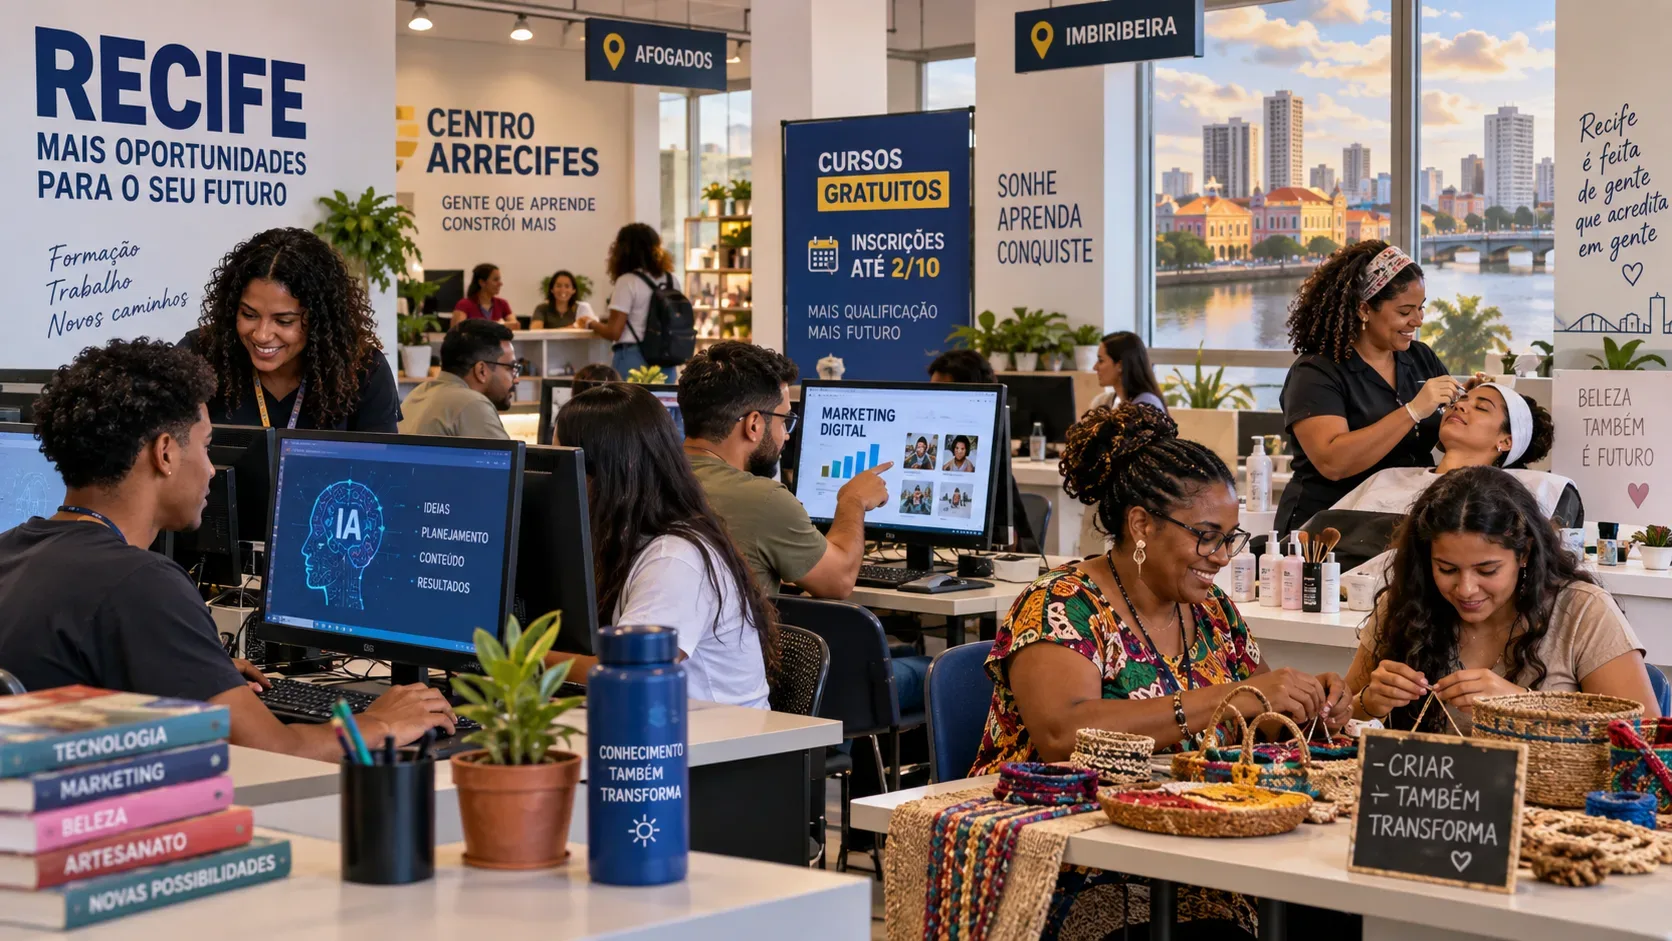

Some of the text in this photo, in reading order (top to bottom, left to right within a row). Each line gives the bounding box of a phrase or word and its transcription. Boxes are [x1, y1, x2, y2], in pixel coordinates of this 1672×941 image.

[1065, 15, 1178, 47] IMBIRIBEIRA
[635, 44, 713, 70] AFOGADOS
[34, 25, 307, 140] RECIFE
[427, 107, 535, 140] CENTRO
[1579, 103, 1638, 143] Recife
[36, 131, 307, 176] MAIS OPORTUNIDADES
[426, 142, 600, 177] ARRECIFES
[818, 148, 903, 173] CURSOS
[1582, 138, 1641, 175] é feita
[37, 170, 287, 207] PARA O SEU FUTURO
[824, 179, 942, 204] GRATUITOS
[998, 170, 1057, 198] SONHE
[1577, 165, 1651, 205] de gente
[442, 195, 596, 213] GENTE QUE APRENDE
[997, 203, 1083, 232] APRENDA
[1575, 190, 1669, 237] que acredita
[442, 214, 556, 232] CONSTRÓI MAIS
[851, 229, 945, 253] INSCRIÇÕES
[997, 238, 1094, 265] CONQUISTE
[1578, 222, 1658, 262] em gente
[48, 241, 141, 272] Formação
[850, 255, 941, 280] ATÉ 2/10
[46, 269, 134, 306] Trabalho
[47, 287, 190, 339] Novos caminhos
[807, 302, 938, 323] MAIS QUALIFICAÇÃO
[807, 325, 901, 341] MAIS FUTURO
[1578, 387, 1632, 408] BELEZA
[821, 406, 896, 422] MARKETING
[1583, 413, 1645, 436] TAMBÉM
[820, 422, 866, 438] DIGITAL
[1582, 444, 1654, 467] É FUTURO
[423, 502, 450, 515] IDEIAS
[336, 507, 362, 541] IA
[421, 526, 489, 544] PLANEJAMENTO
[419, 551, 465, 568] CONTEÚDO
[417, 576, 470, 594] RESULTADOS
[53, 726, 168, 762] TECNOLOGIA
[599, 742, 684, 760] CONHECIMENTO
[60, 763, 165, 800] MARKETING
[608, 764, 664, 781] TAMBÉM
[600, 784, 682, 802] TRANSFORMA
[1395, 783, 1480, 812] TAMBÉM
[61, 807, 128, 837] BELEZA
[1368, 814, 1498, 846] TRANSFORMA
[64, 832, 188, 875] ARTESANATO
[89, 854, 276, 914] NOVAS POSSIBILIDADES
